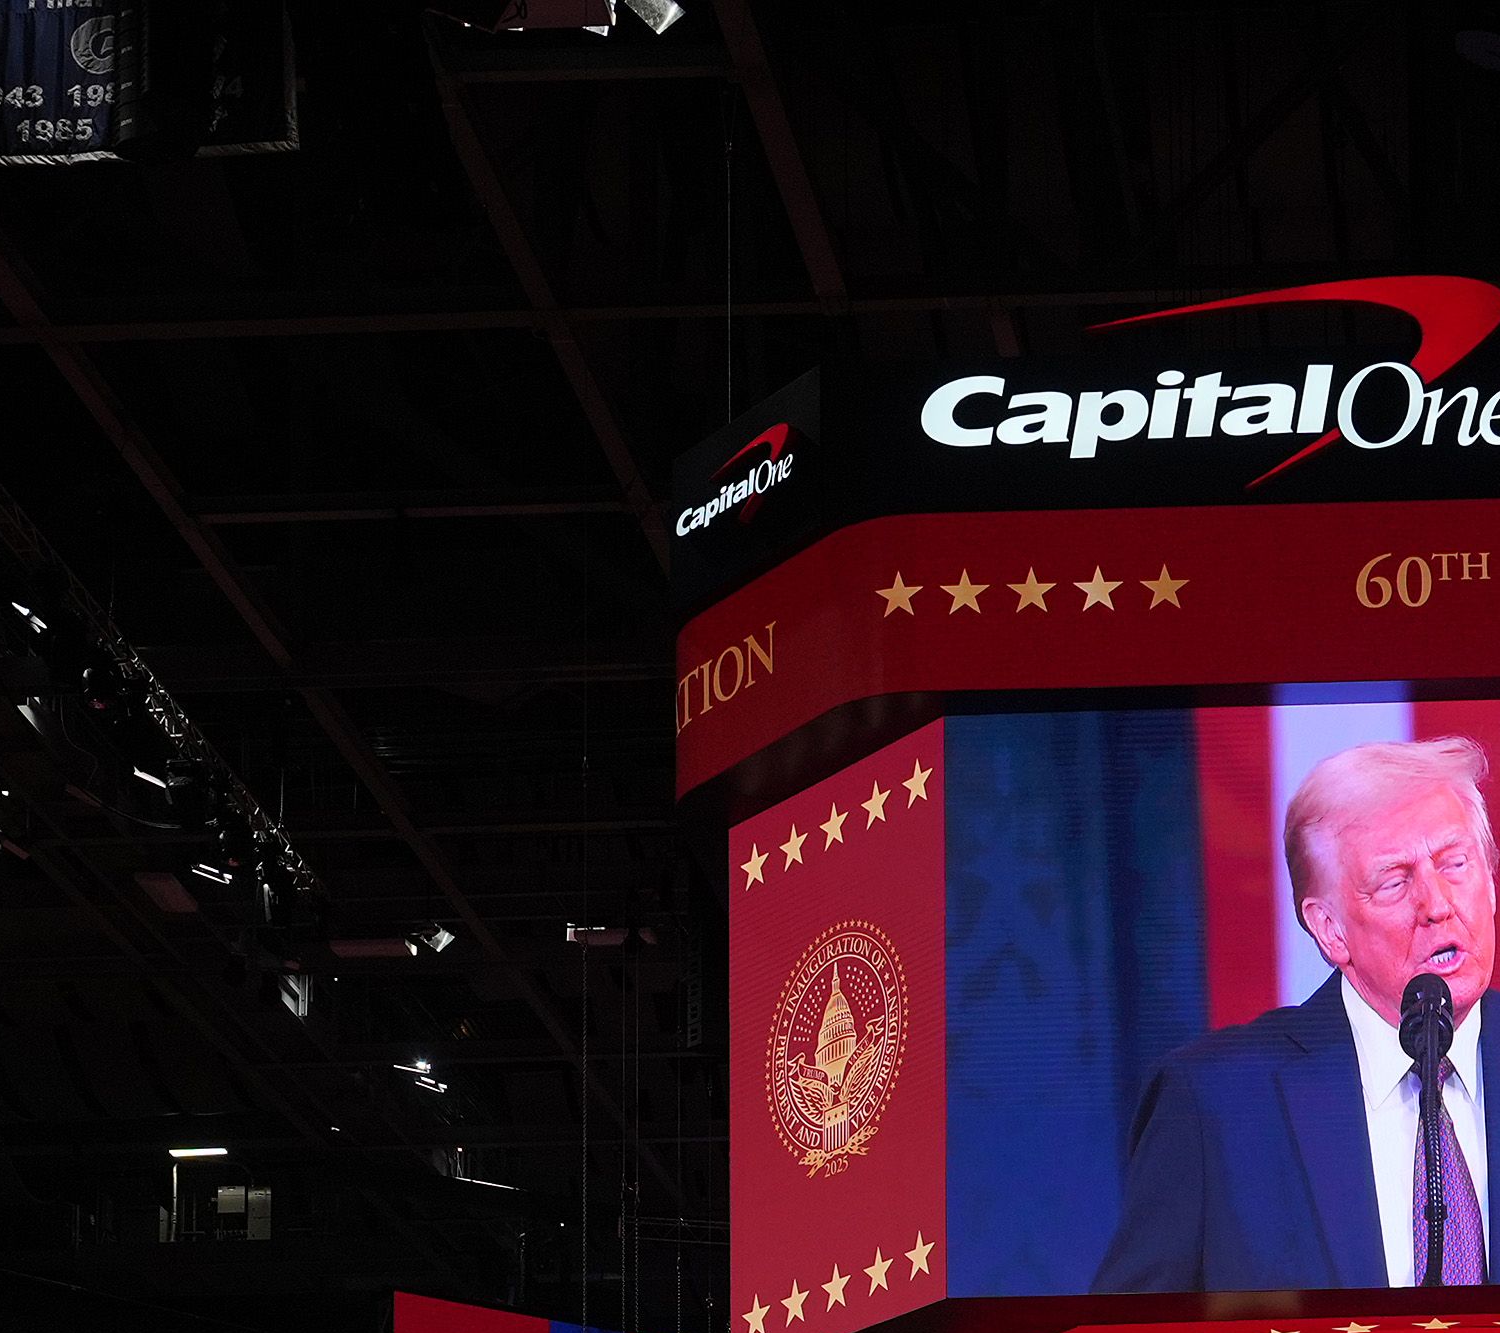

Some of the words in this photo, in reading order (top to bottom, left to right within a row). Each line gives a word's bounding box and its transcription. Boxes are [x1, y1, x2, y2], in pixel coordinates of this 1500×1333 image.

[67, 84, 116, 107] 198
[16, 118, 94, 143] 1985
[1355, 550, 1490, 609] 60TH
[676, 621, 776, 738] TION
[785, 937, 872, 1014] INAUGURATION
[871, 946, 887, 971] OF
[775, 1034, 799, 1133] PRESIDENT
[795, 1125, 820, 1148] AND
[850, 1092, 879, 1130] VICE
[876, 984, 900, 1089] PRESIDENT
[824, 1156, 849, 1178] 2025
